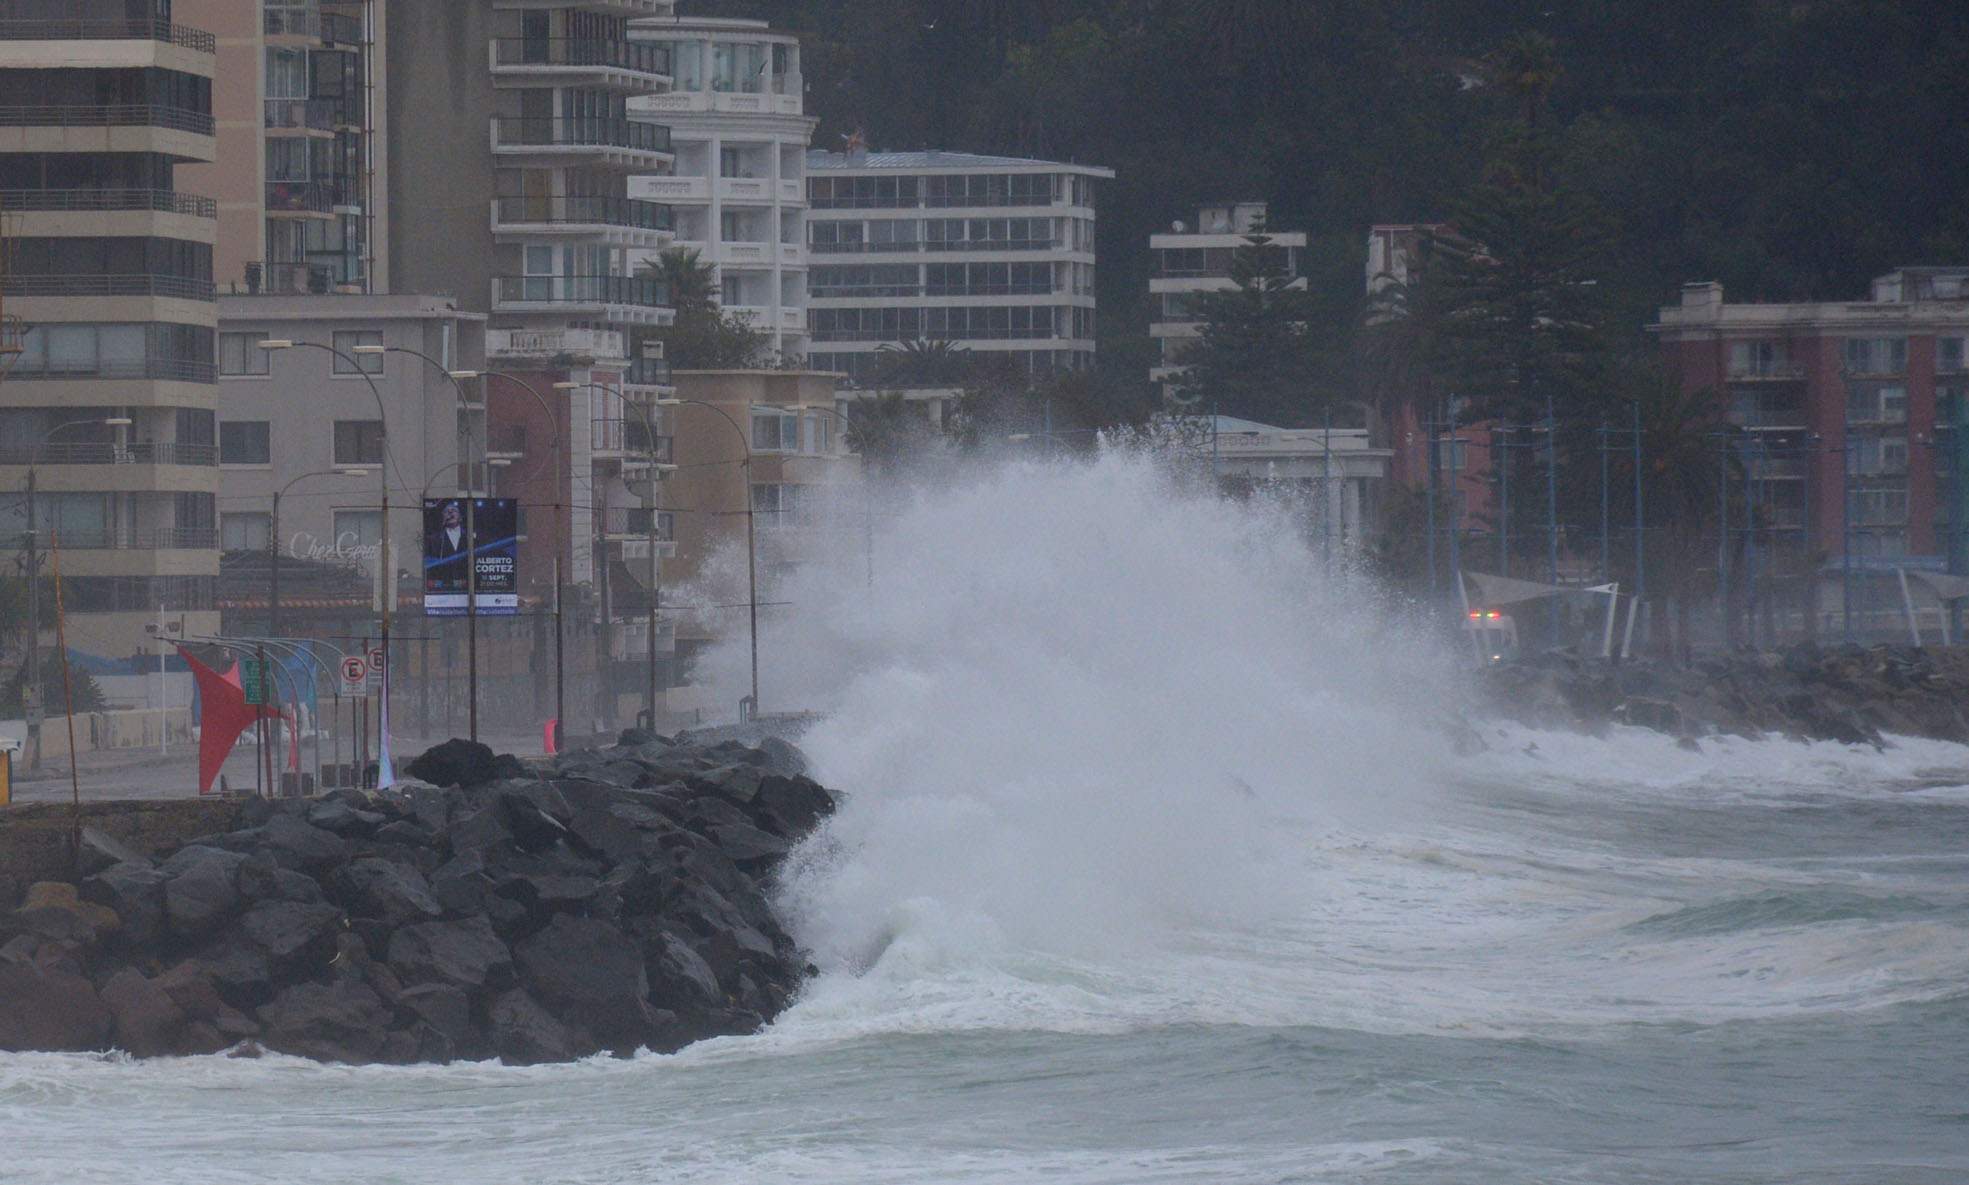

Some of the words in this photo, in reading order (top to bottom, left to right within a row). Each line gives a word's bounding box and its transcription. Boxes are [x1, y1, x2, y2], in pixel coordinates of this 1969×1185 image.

[476, 557, 512, 565] ALBERTO
[475, 565, 514, 573] CORTEZ
[348, 661, 360, 677] E
